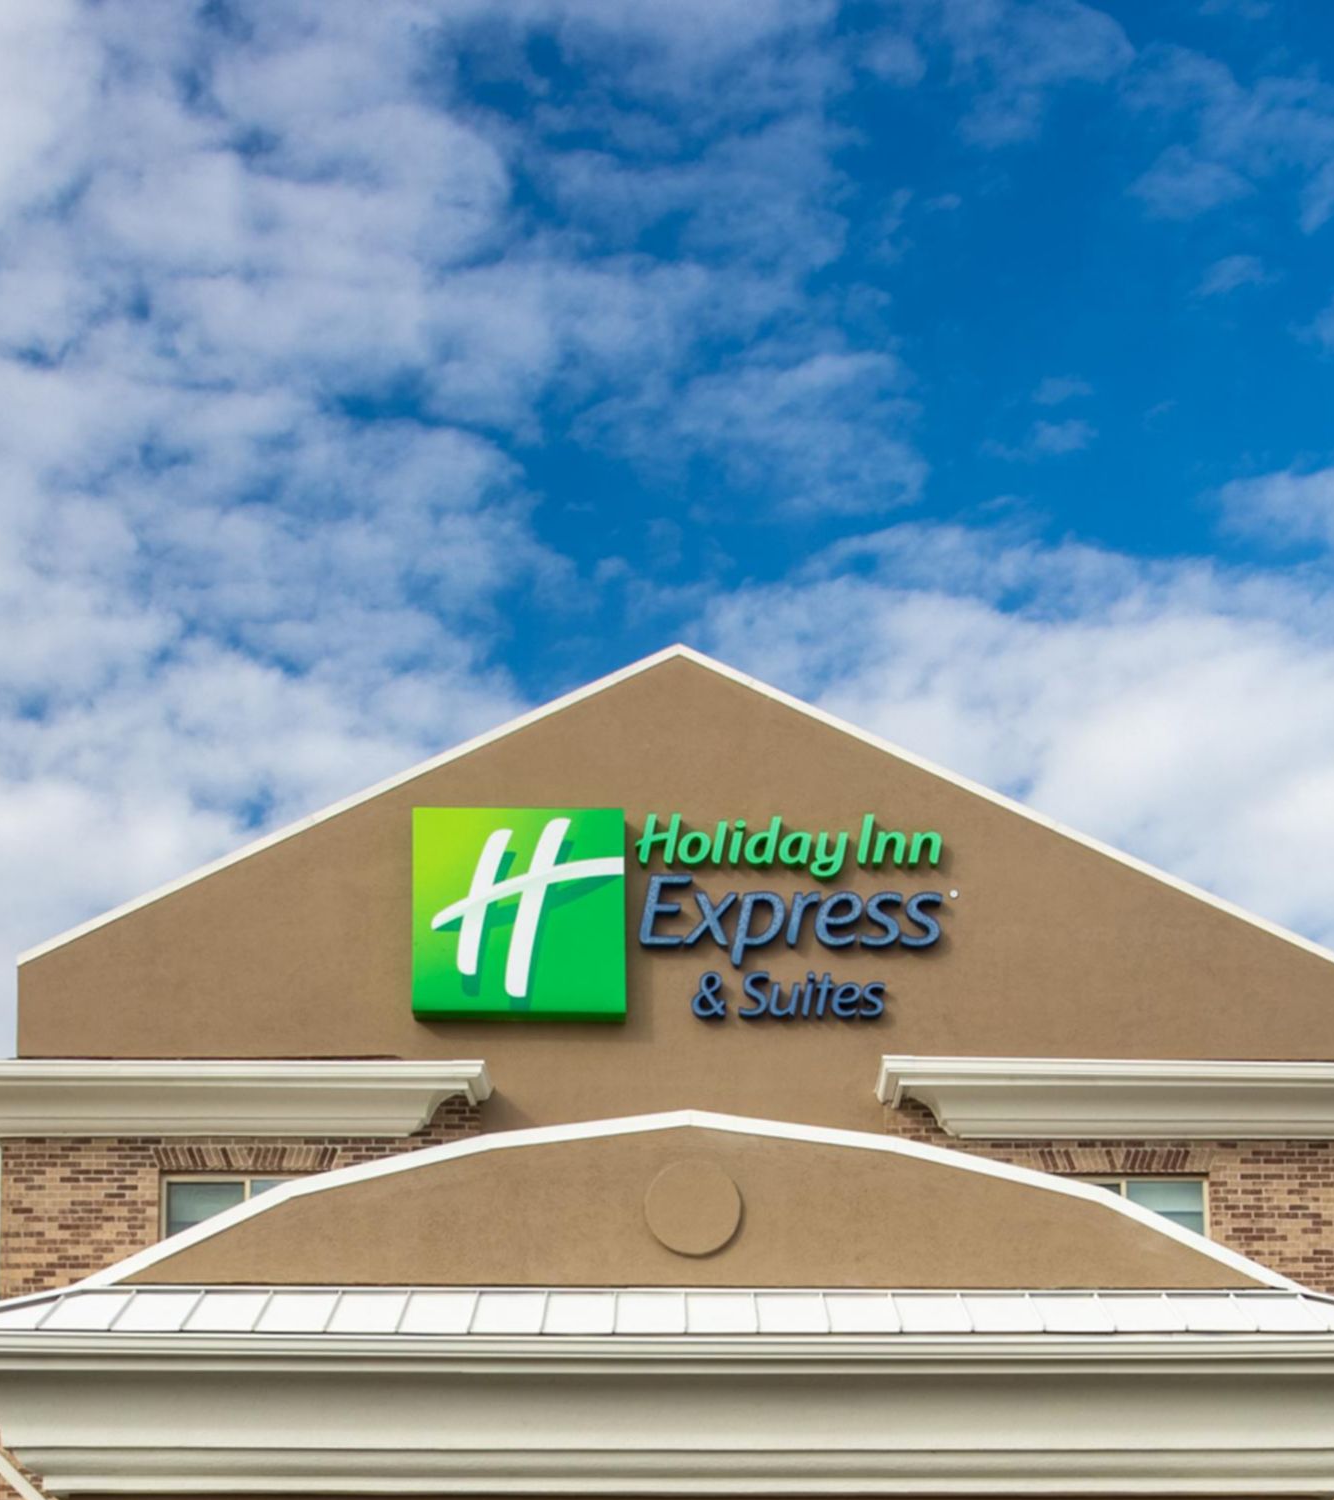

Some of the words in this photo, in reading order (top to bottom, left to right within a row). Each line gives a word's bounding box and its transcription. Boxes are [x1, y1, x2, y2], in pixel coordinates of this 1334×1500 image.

[635, 813, 848, 878] Holiday
[857, 813, 942, 865] Inn
[432, 818, 624, 998] H
[638, 873, 943, 967] Express
[691, 972, 727, 1020] &
[738, 971, 886, 1021] Suites
